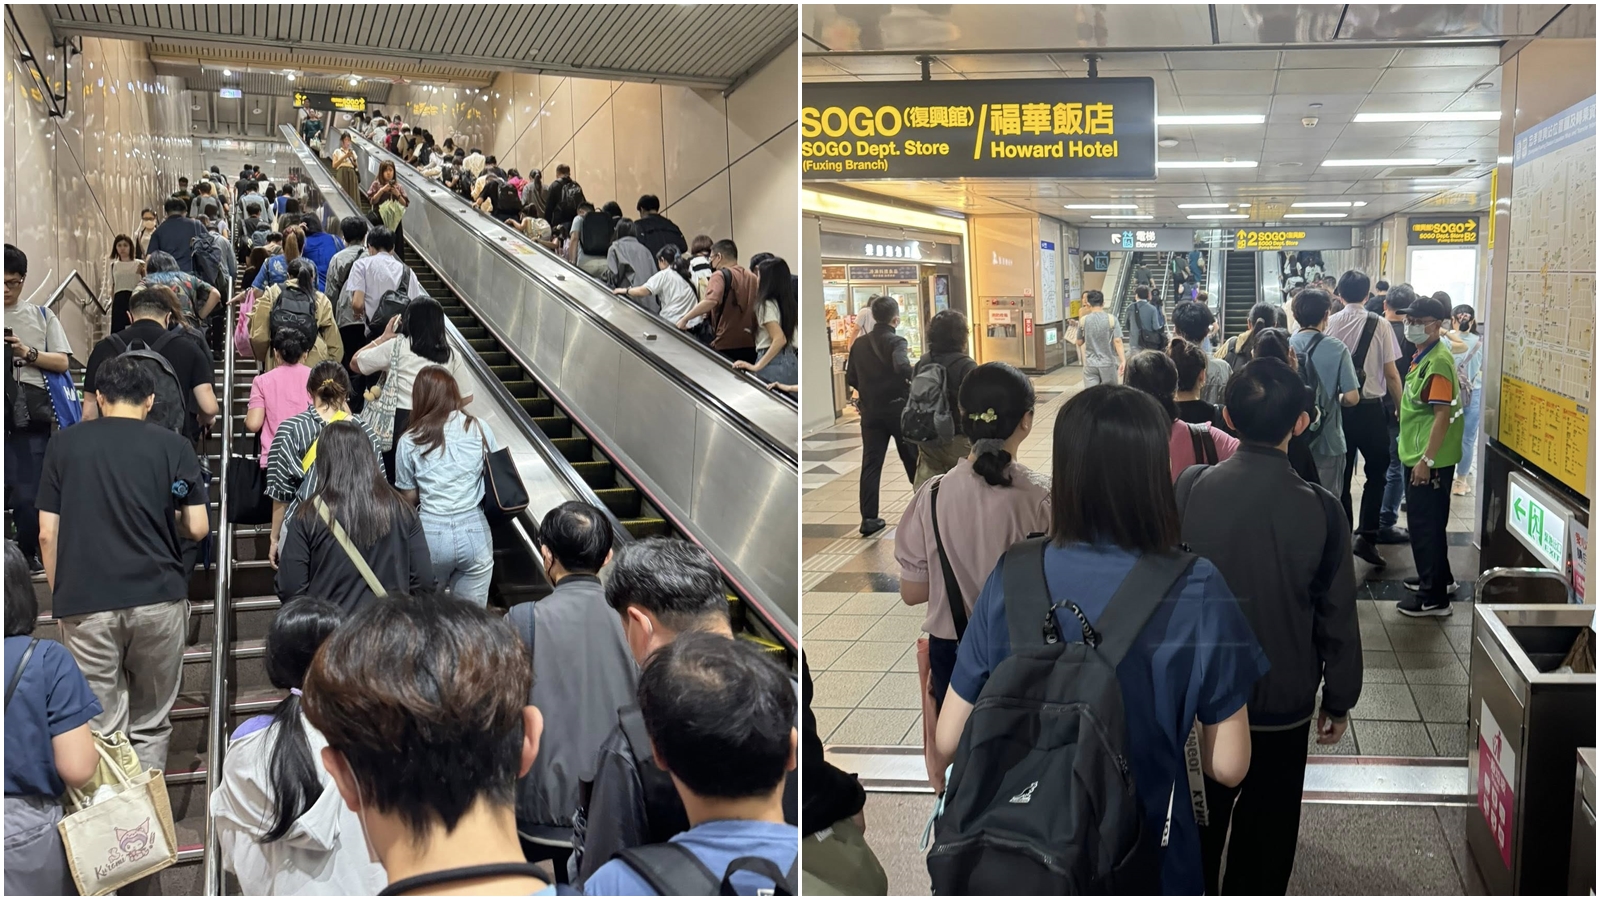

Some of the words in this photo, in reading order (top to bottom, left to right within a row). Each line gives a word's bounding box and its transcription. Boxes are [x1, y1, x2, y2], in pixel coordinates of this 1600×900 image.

[802, 106, 902, 137] SOGO
[903, 106, 975, 129] (復興館)
[990, 102, 1115, 135] 福華飯店
[802, 141, 852, 157] SOGO
[856, 141, 900, 160] Dept.
[904, 140, 949, 156] Store
[991, 141, 1064, 158] Howard
[1068, 140, 1119, 158] Hotel
[802, 159, 843, 173] (Fuxing
[845, 159, 889, 172] Branch)
[1433, 223, 1465, 233] SOGO
[1247, 231, 1258, 247] 2
[1258, 231, 1286, 241] SOGO
[1464, 232, 1477, 242] B2
[1544, 545, 1560, 562] EXIT
[94, 854, 125, 880] Kuromi
